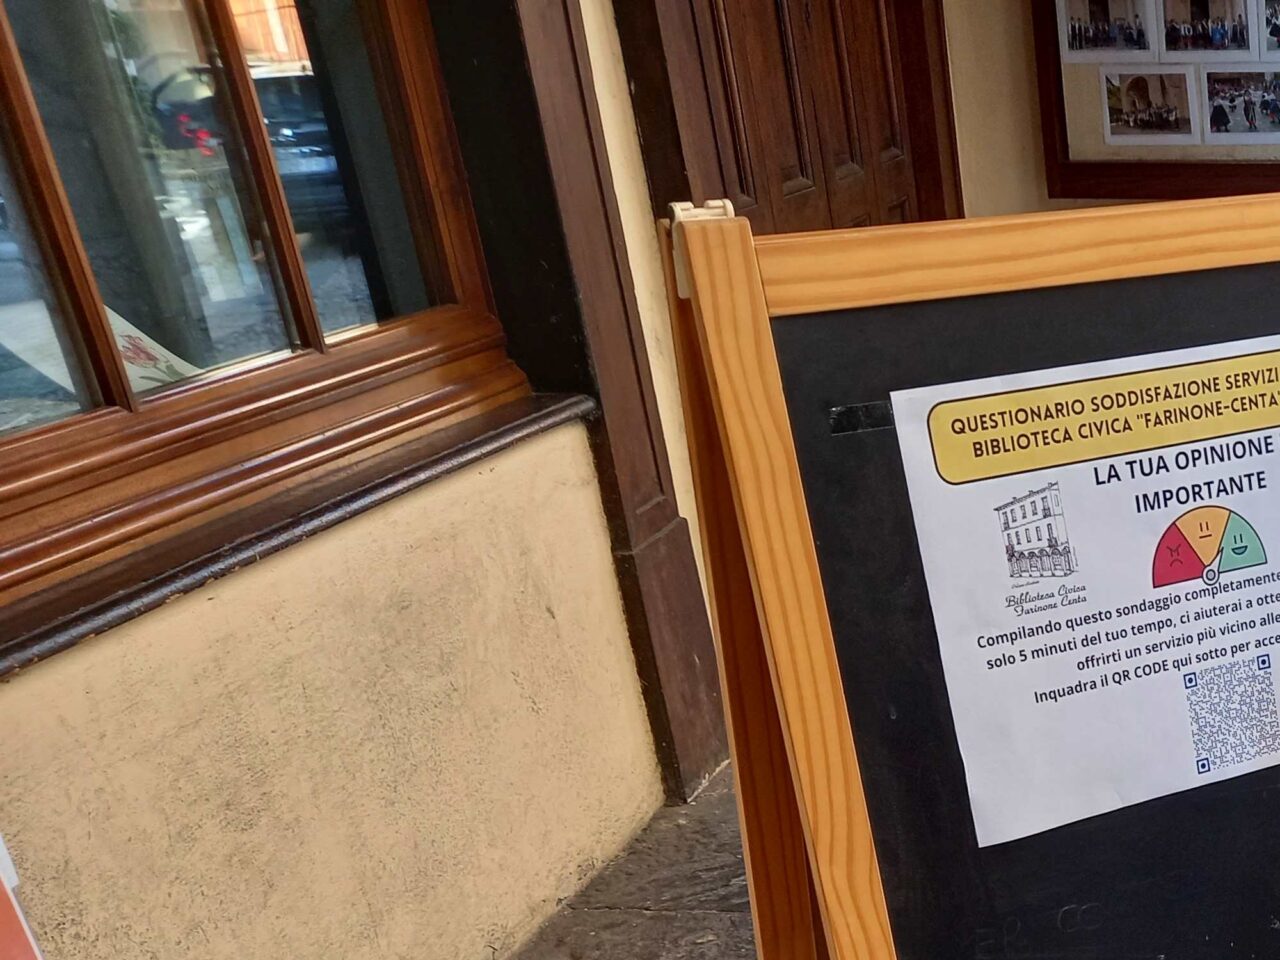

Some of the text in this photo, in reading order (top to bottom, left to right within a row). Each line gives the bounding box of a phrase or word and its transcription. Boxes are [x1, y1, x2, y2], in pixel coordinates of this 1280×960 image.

[951, 399, 1085, 435] QUESTIONARIO
[1091, 376, 1221, 412] SODDISFAZIONE
[1225, 367, 1279, 390] SERVIZI
[972, 426, 1073, 458] BIBLIOTECA
[1078, 416, 1133, 439] CIVICA
[1094, 464, 1122, 486] LA
[1125, 455, 1170, 480] TUA
[1175, 435, 1275, 470] OPINIONE
[1135, 470, 1267, 514] IMPORTANTE
[977, 620, 1062, 648] Compilando
[1065, 609, 1112, 631] questo
[1116, 591, 1181, 618] sondaggio
[1005, 591, 1055, 609] Biblioteca
[1057, 584, 1087, 597] Civica
[1013, 595, 1087, 617] Farinone Centa
[986, 653, 1016, 670] solo
[1019, 649, 1028, 663] 5
[1031, 638, 1078, 660] minuti
[1081, 632, 1101, 648] del
[1105, 629, 1127, 643] tuo
[1131, 618, 1177, 637] tempo,
[1179, 610, 1190, 625] ci
[1193, 598, 1242, 622] aiuterai
[1245, 599, 1253, 609] a
[1076, 650, 1122, 671] offrirti
[1125, 646, 1141, 658] un
[1145, 632, 1193, 655] servizio
[1197, 627, 1216, 645] più
[1219, 618, 1256, 636] vicino
[1034, 677, 1098, 704] Inquadra
[1101, 673, 1109, 688] il
[1111, 670, 1131, 685] QR
[1134, 660, 1170, 679] CODE
[1172, 652, 1192, 672] qui
[1195, 647, 1227, 664] sotto
[1230, 641, 1250, 659] per
